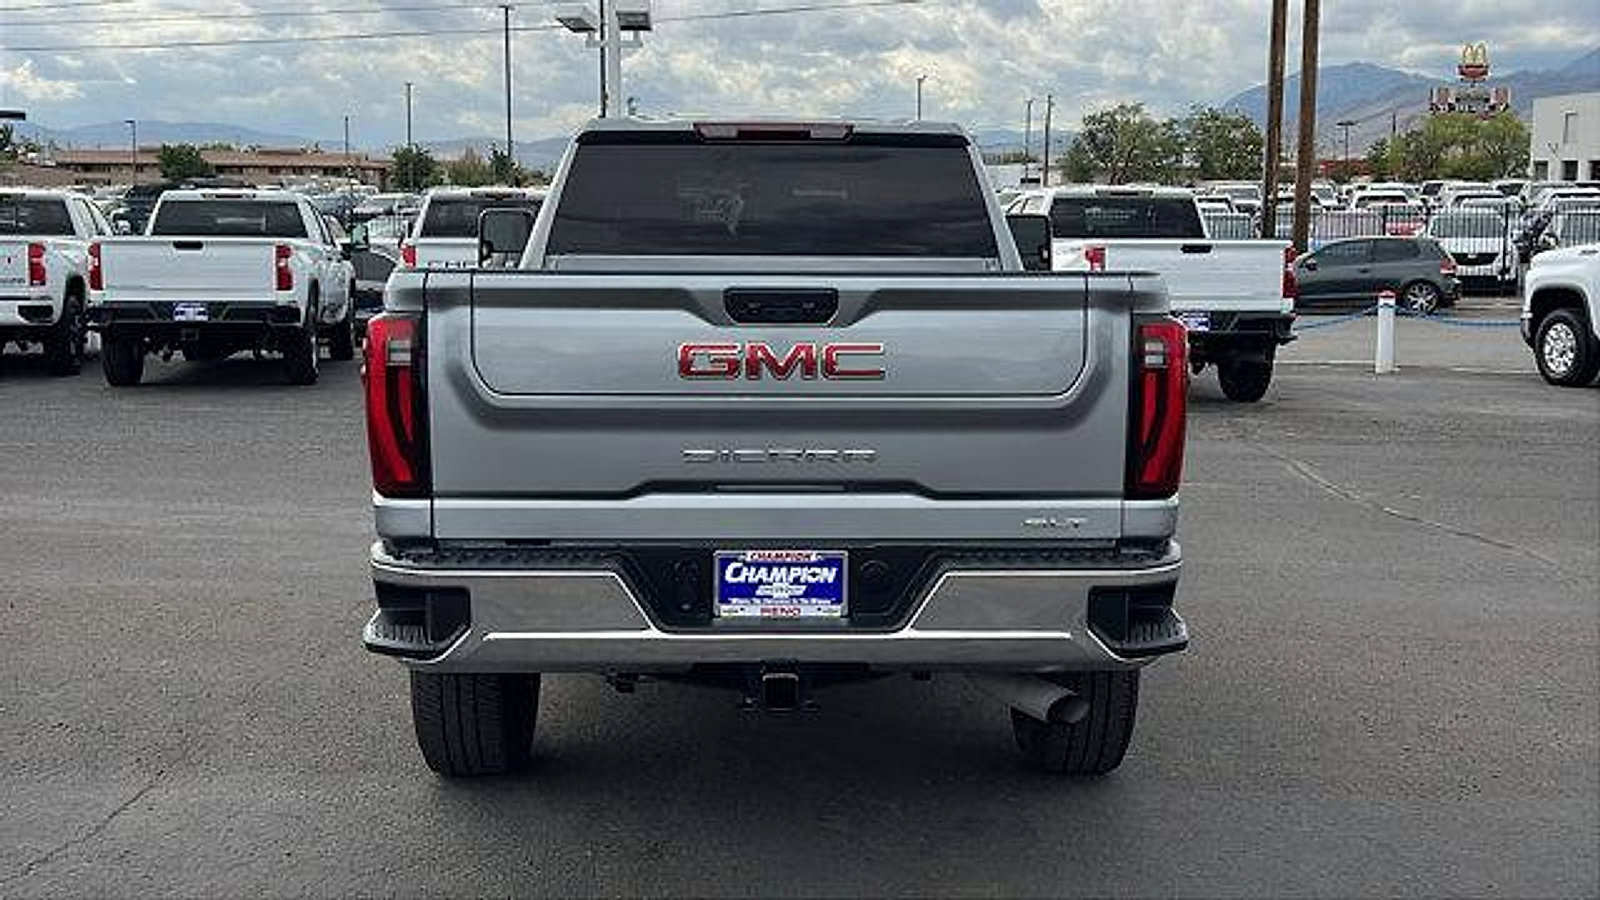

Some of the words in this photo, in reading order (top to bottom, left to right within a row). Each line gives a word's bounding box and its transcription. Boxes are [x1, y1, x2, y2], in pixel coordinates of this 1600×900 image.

[679, 342, 885, 380] GMC
[750, 551, 812, 561] CHAMPION
[725, 562, 838, 583] CHAMPION
